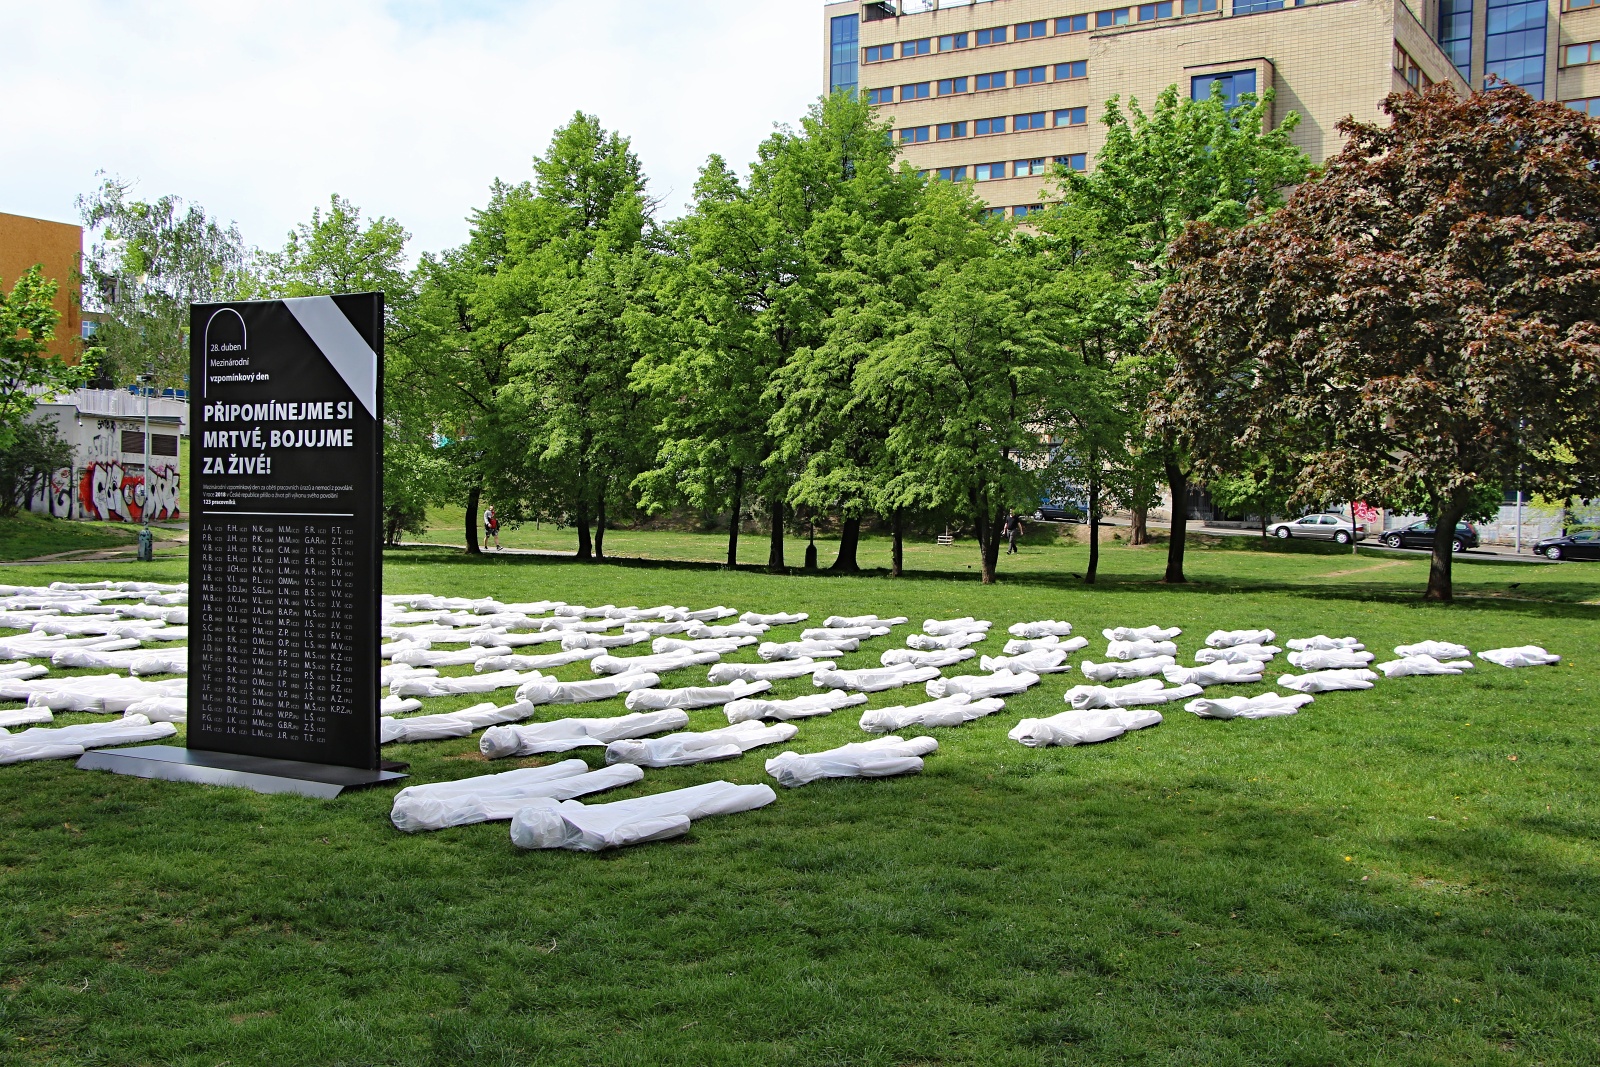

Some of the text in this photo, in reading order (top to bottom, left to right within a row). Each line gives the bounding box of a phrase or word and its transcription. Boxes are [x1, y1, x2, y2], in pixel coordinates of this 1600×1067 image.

[221, 343, 241, 351] duben
[210, 357, 249, 367] Mezinárodní
[210, 372, 269, 384] vzpomínkový den
[204, 400, 353, 422] PŘIPOMÍNEJME SI
[203, 427, 353, 450] MRTVÉ, BOJUJME
[203, 454, 271, 474] ZA ŽIVÉ!
